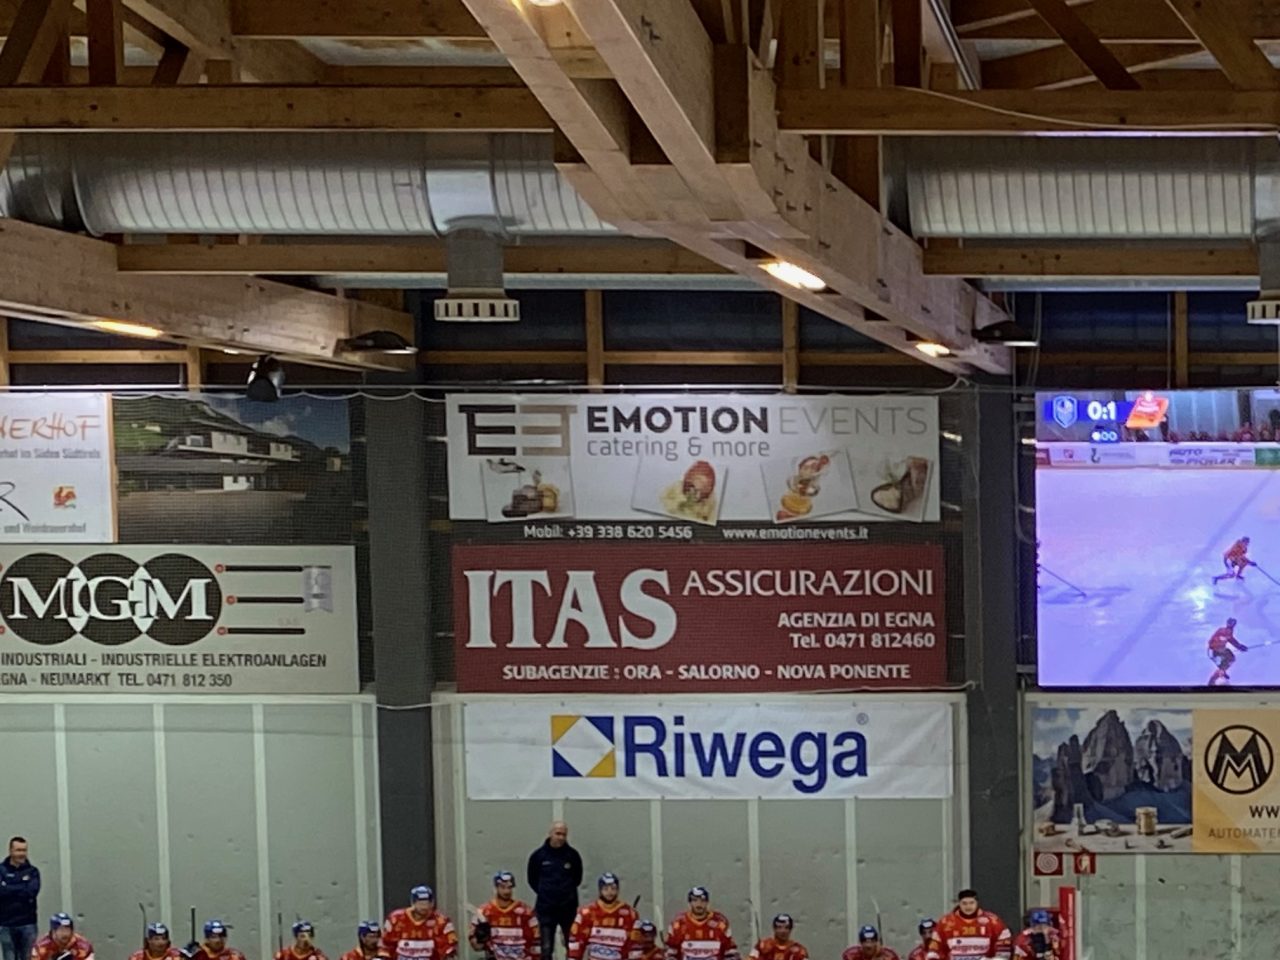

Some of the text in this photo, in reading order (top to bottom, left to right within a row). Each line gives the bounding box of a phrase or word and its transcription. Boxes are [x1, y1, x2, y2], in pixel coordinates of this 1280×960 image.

[1087, 401, 1116, 420] 0:1
[586, 406, 928, 435] EMOTION EVENTS
[587, 436, 770, 461] catering & more
[523, 525, 563, 539] Mobil:
[568, 526, 594, 539] +39
[597, 526, 624, 539] 338
[657, 525, 693, 539] 5456
[722, 525, 869, 541] www.emotionevents.it
[682, 569, 933, 597] ASSICURAZIONI
[6, 576, 214, 620] MGM
[464, 569, 677, 649] ITAS
[777, 612, 935, 629] AGENZIA DI EGNA
[790, 633, 935, 649] Tel. 0471 812460
[1, 653, 87, 667] INDUSTRIALI
[101, 653, 198, 667] INDUSTRIELLE
[202, 653, 326, 667] ELEKTROANLAGEN
[0, 673, 27, 686] GNA
[40, 672, 110, 687] NEUMARKT
[147, 673, 176, 687] 0471
[182, 673, 205, 687] 812
[209, 673, 232, 687] 350
[502, 665, 610, 680] SUBAGENZIE
[623, 665, 661, 680] ORA
[678, 665, 760, 680] SALORNO
[777, 665, 827, 680] NOVA
[830, 665, 911, 680] PONENTE
[622, 715, 868, 794] Riwega
